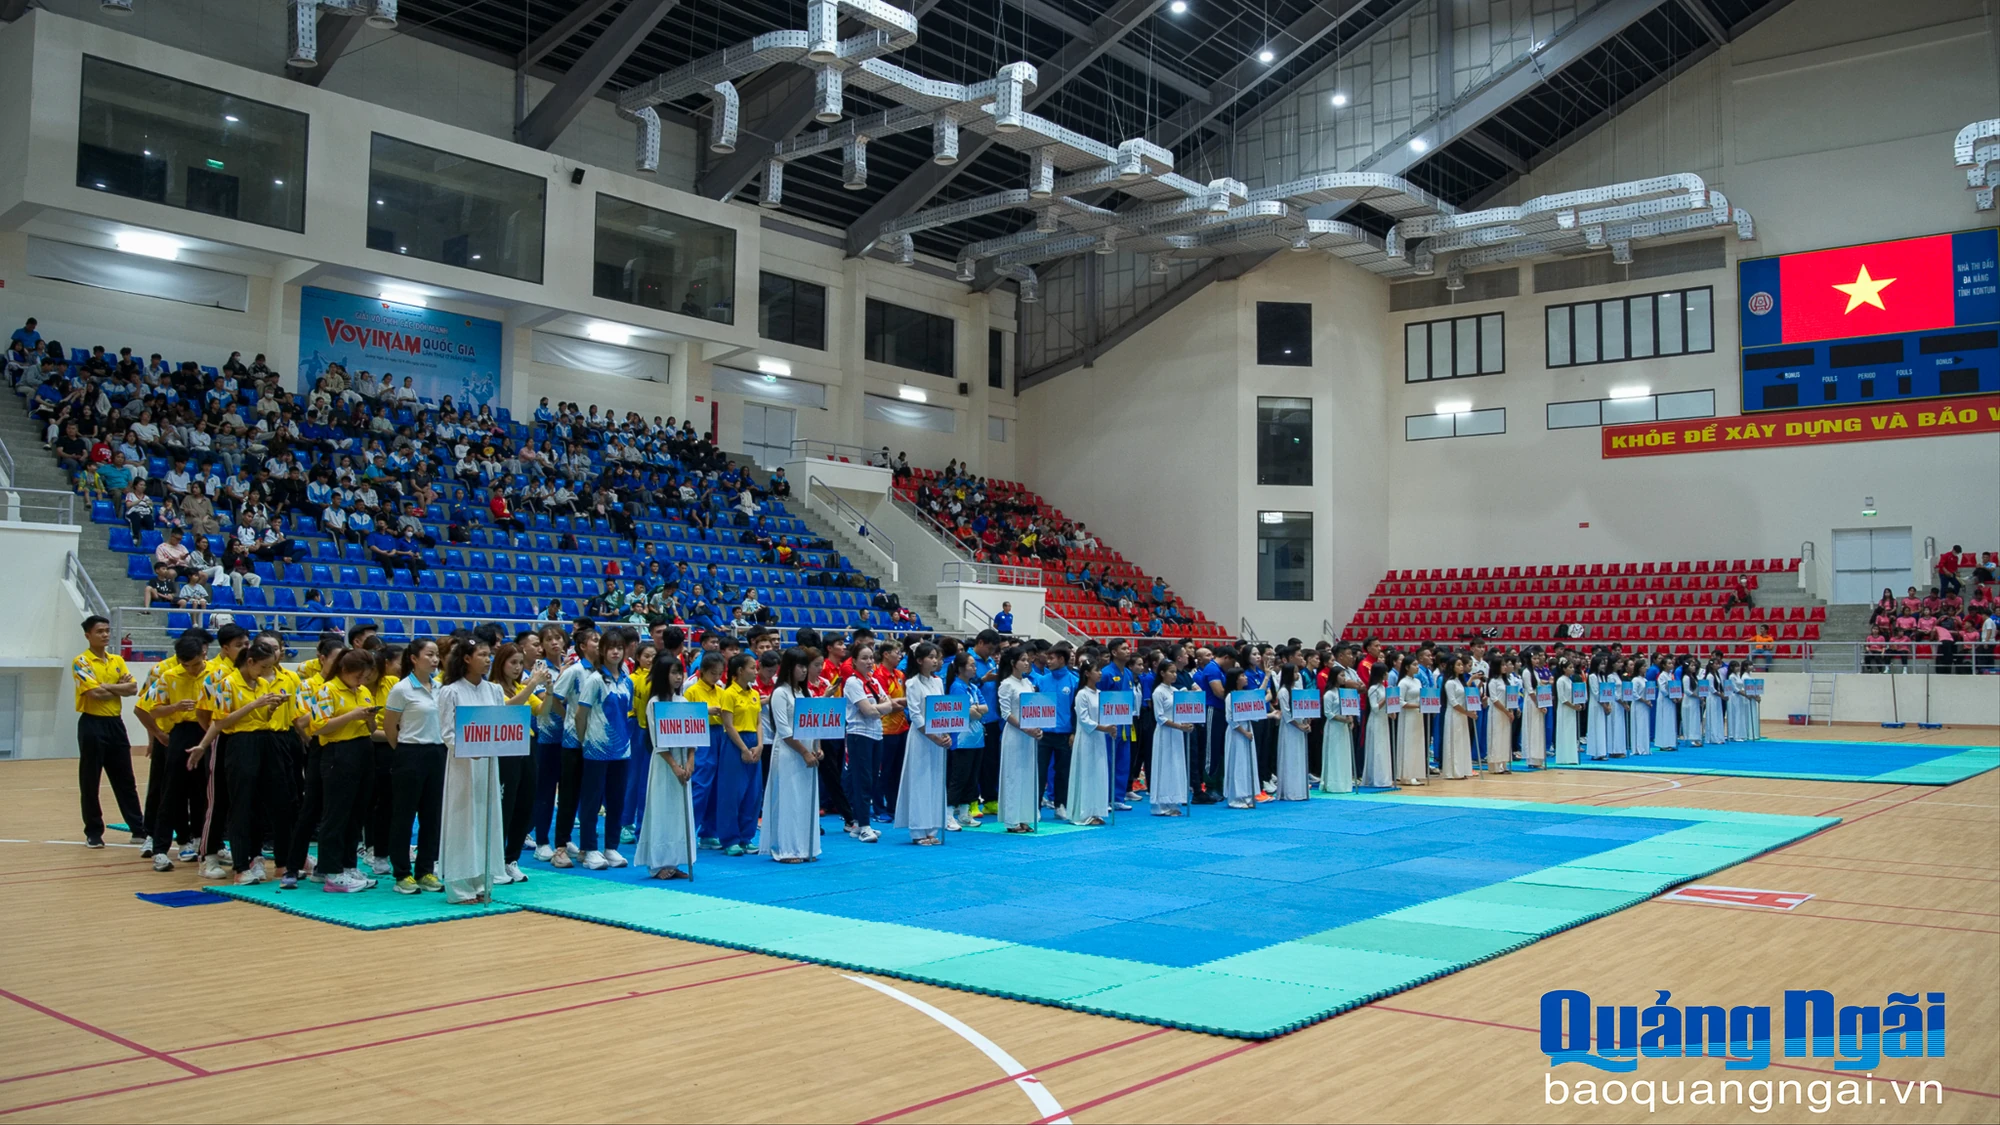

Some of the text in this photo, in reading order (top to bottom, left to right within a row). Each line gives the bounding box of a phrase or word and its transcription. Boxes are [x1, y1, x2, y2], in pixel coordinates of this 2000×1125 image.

[1963, 275, 1971, 284] ĐA
[1972, 285, 1996, 296] KONTUM
[323, 316, 421, 357] VOVINAM
[423, 338, 475, 357] QUỐC GIA
[1936, 357, 1953, 366] BONUS
[1784, 371, 1801, 379] BONUS
[1857, 372, 1876, 380] PERIOD
[1896, 368, 1913, 377] FOULS
[1822, 375, 1838, 383] FOULS
[1611, 428, 1676, 449] KHỎE
[1683, 423, 1717, 444] ĐỂ
[1725, 423, 1777, 441] XÂY
[1785, 418, 1862, 438] DỰNG
[1871, 411, 1909, 430] VÀ
[1917, 405, 1979, 427] BẢO
[934, 701, 963, 712] CÔNG AN
[1022, 703, 1056, 719] QUẢNG NINH
[1103, 702, 1130, 716] TÂY NINH
[1176, 702, 1193, 714] KHÁNH
[1234, 702, 1252, 714] THANH
[799, 709, 842, 728] ĐẮK LẮK
[931, 716, 965, 728] NHÂN DÂN
[659, 717, 706, 735] NINH BÌNH
[463, 723, 524, 743] VĨNH LONG
